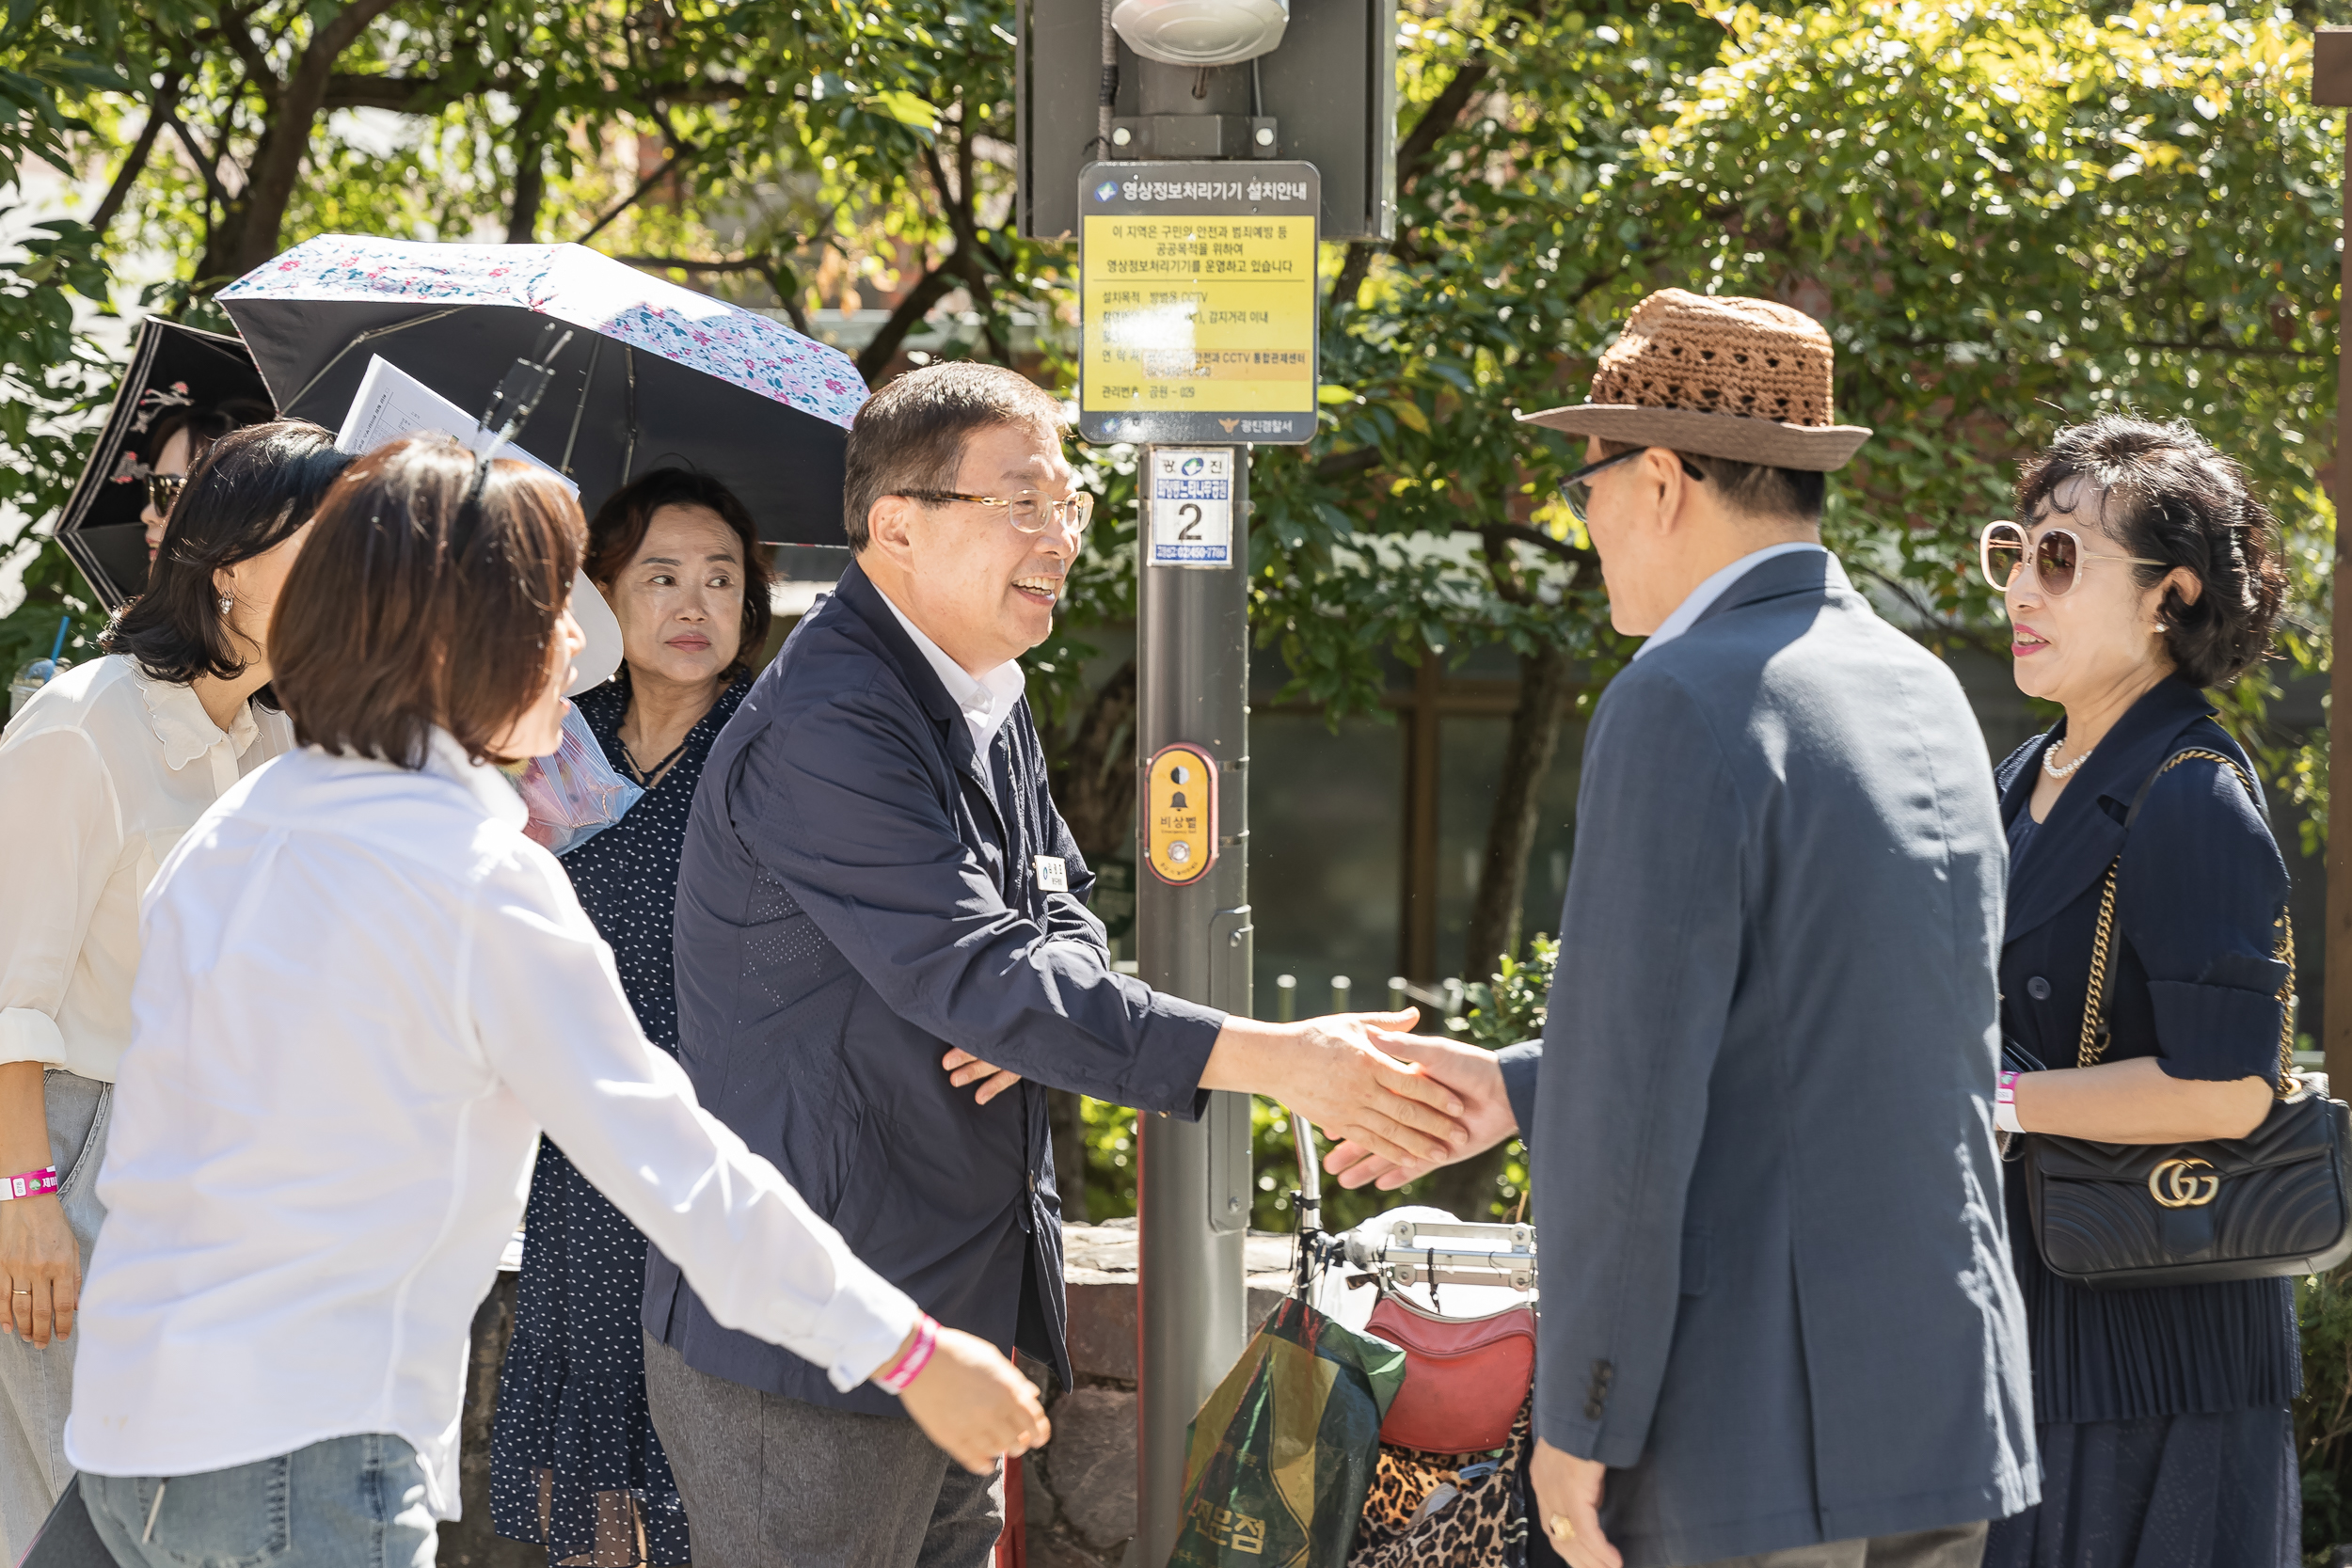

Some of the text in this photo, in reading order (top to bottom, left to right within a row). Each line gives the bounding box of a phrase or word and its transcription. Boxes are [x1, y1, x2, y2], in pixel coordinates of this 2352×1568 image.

[1122, 181, 1307, 200] 영상정보처리기기 설치안내
[1112, 226, 1287, 240] 이 지역은 구민의 안전과 범죄예방 등
[1157, 243, 1244, 256] 공공목적을 위하여
[1106, 260, 1293, 273] 영상정보처리기기를 운영하고 있습니다
[1103, 291, 1140, 304] 설치목적
[1210, 311, 1247, 325] 감지거리
[1249, 311, 1268, 324] 이내
[1222, 352, 1250, 363] CCTV
[1254, 352, 1305, 364] 통합관제센터
[1150, 386, 1168, 399] 공원
[1178, 503, 1202, 540] 2
[1161, 816, 1197, 829] 비상벨
